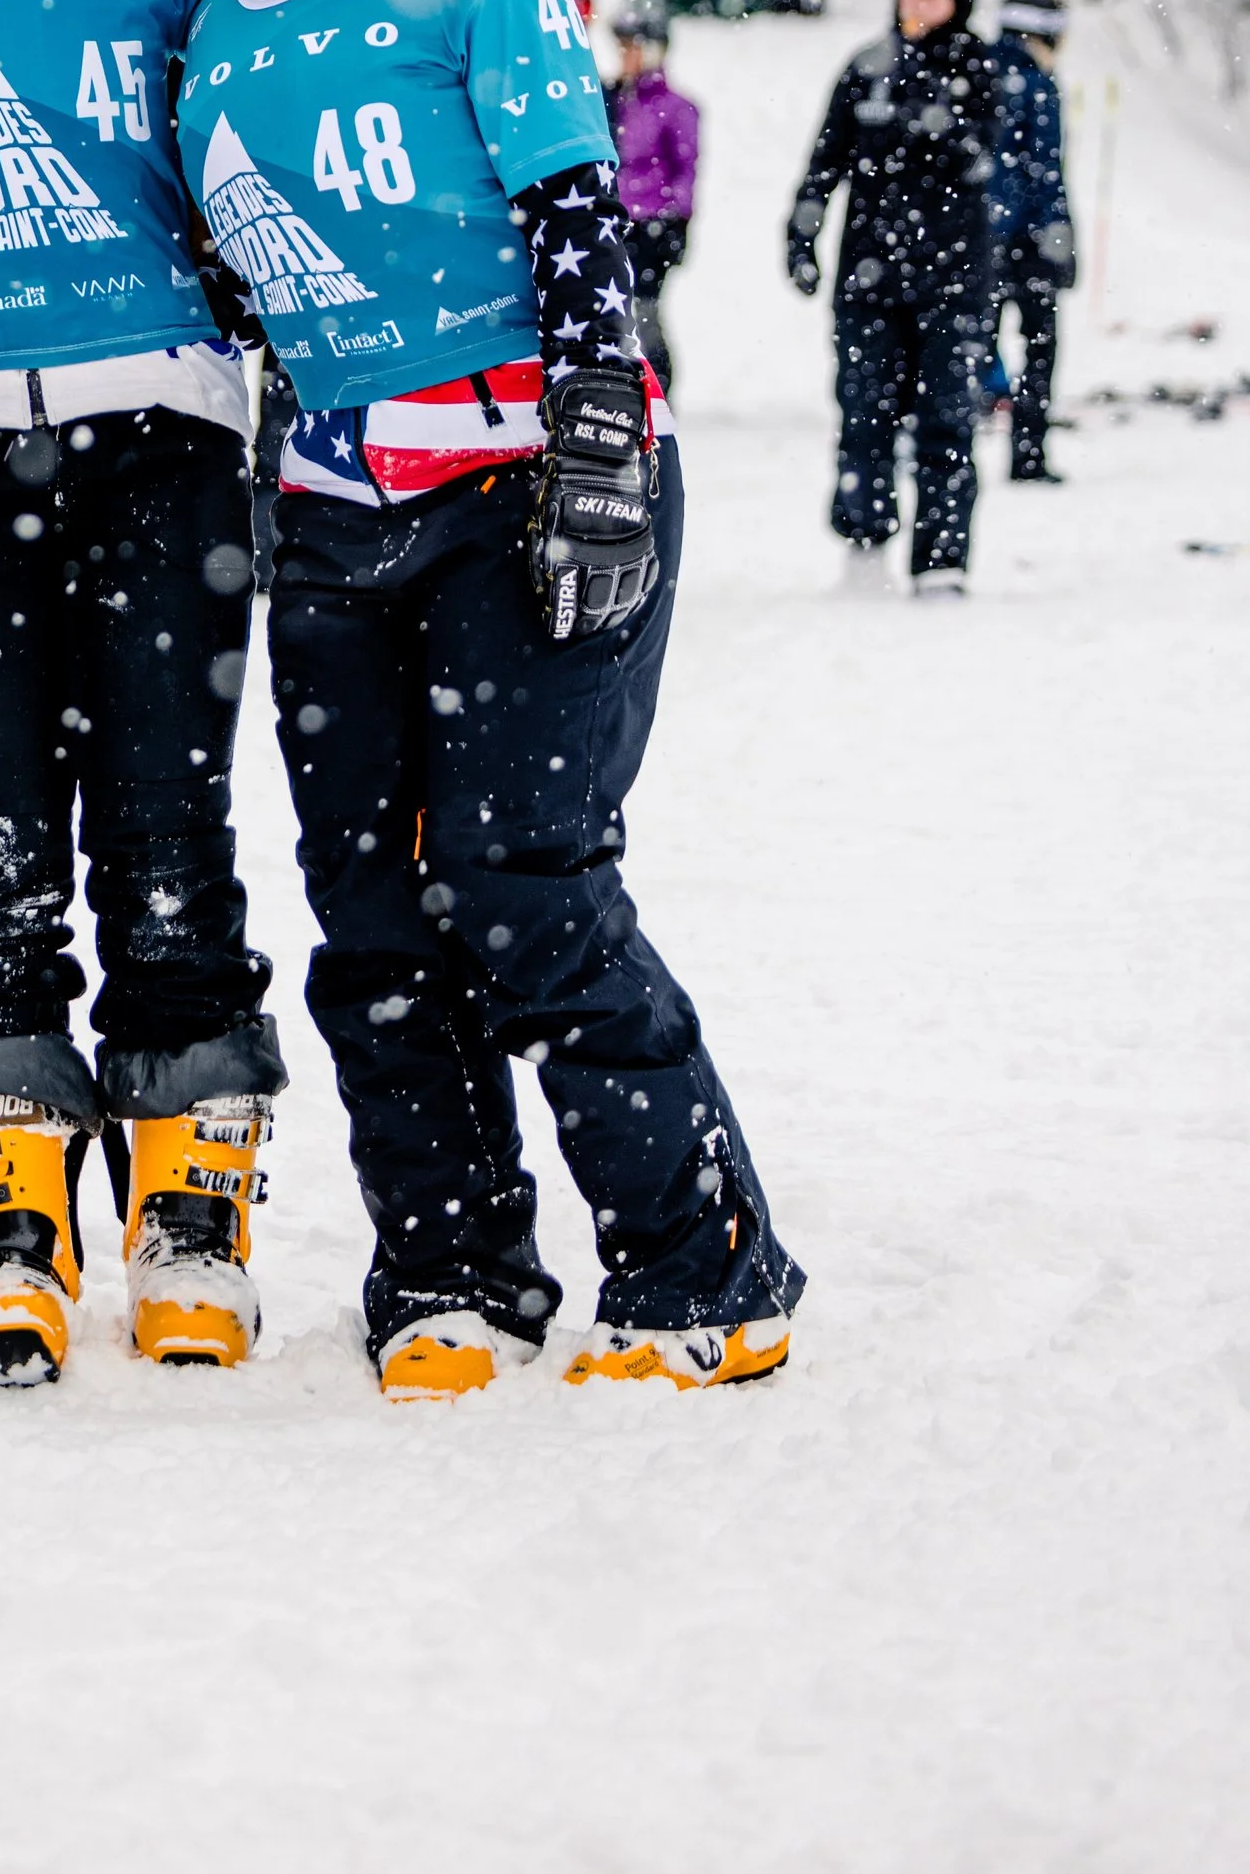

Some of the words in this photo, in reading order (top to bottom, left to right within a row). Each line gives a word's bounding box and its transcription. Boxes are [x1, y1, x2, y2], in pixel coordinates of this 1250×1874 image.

[184, 21, 399, 101] VOLVO
[76, 39, 152, 142] 45
[313, 102, 416, 212] 48
[262, 268, 379, 315] SAINT-CÔME
[461, 293, 520, 320] SAINT-CÔME
[574, 422, 596, 441] RSL
[599, 428, 629, 447] COMP
[580, 401, 616, 425] Vertical
[574, 496, 604, 515] SKI
[606, 500, 643, 523] TEAM
[553, 567, 578, 640] HESTRA
